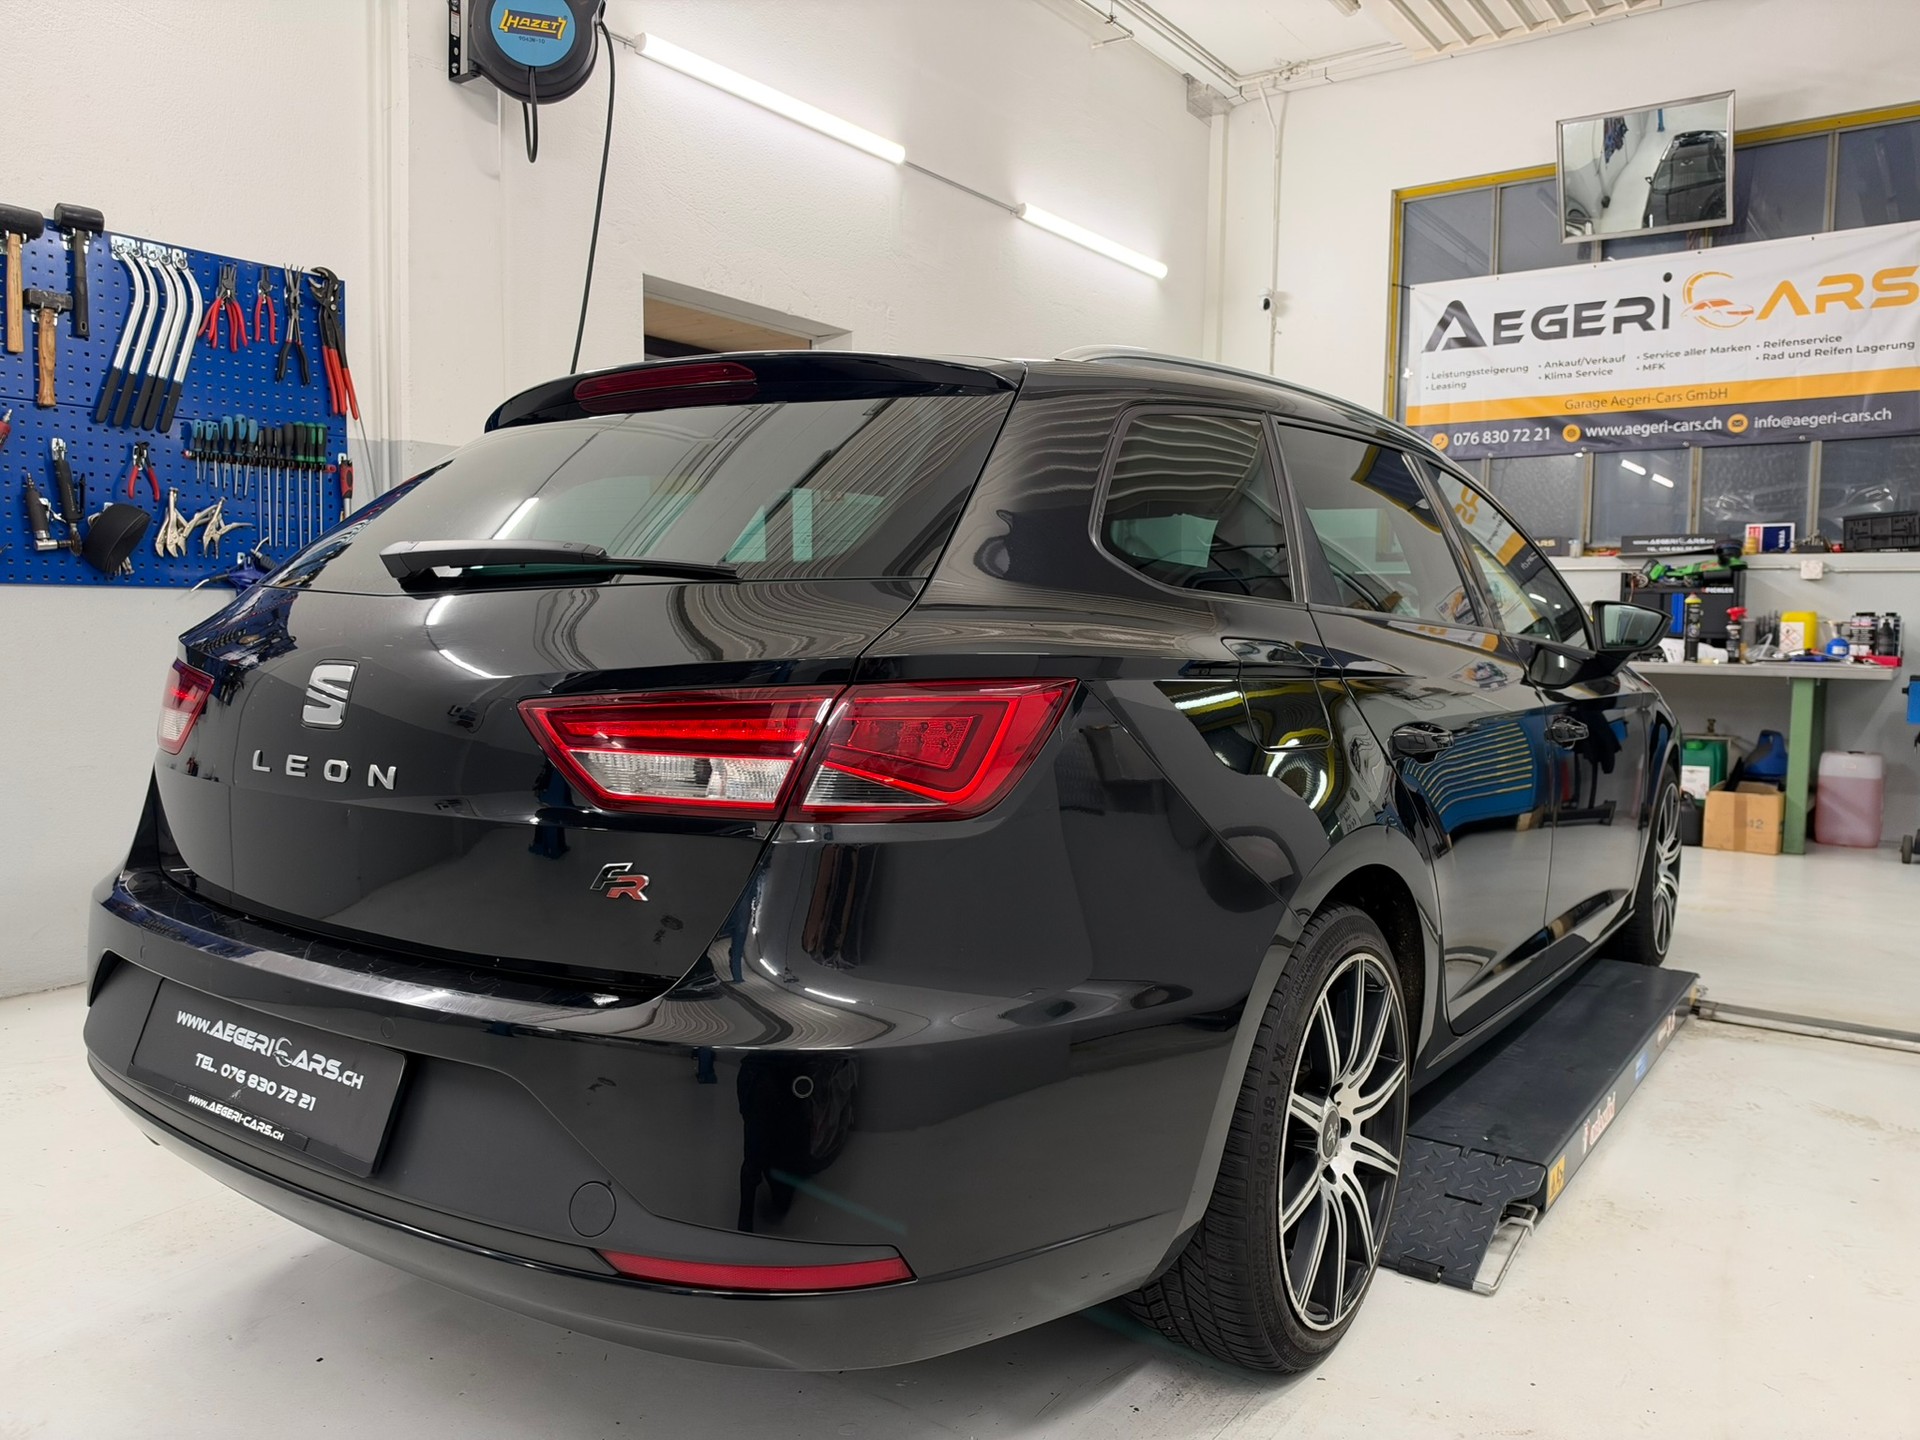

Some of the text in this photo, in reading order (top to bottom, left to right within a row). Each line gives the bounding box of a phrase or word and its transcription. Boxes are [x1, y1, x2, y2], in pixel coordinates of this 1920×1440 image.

[1763, 333, 1843, 349] Reifenservice
[1642, 343, 1751, 361] Service aller Marken
[1763, 341, 1916, 361] Rad und Reifen Lagerung
[1544, 354, 1626, 369] Ankauf/Verkauf
[1642, 362, 1666, 372] MFK
[1431, 364, 1529, 380] Leistungssteigerung
[1544, 367, 1613, 381] Klima Service
[1431, 381, 1467, 391] Leasing
[1565, 388, 1729, 411] Garage Aegeri-Cars GmbH
[1585, 416, 1722, 438] www.aegeri-cars.ch
[1754, 407, 1892, 430] info@aegeri-cars.ch
[1453, 427, 1550, 446] 076 830 72 21
[252, 749, 398, 791] LEON
[590, 862, 650, 902] FR
[195, 1053, 317, 1112] TEL. 076 830 72 21
